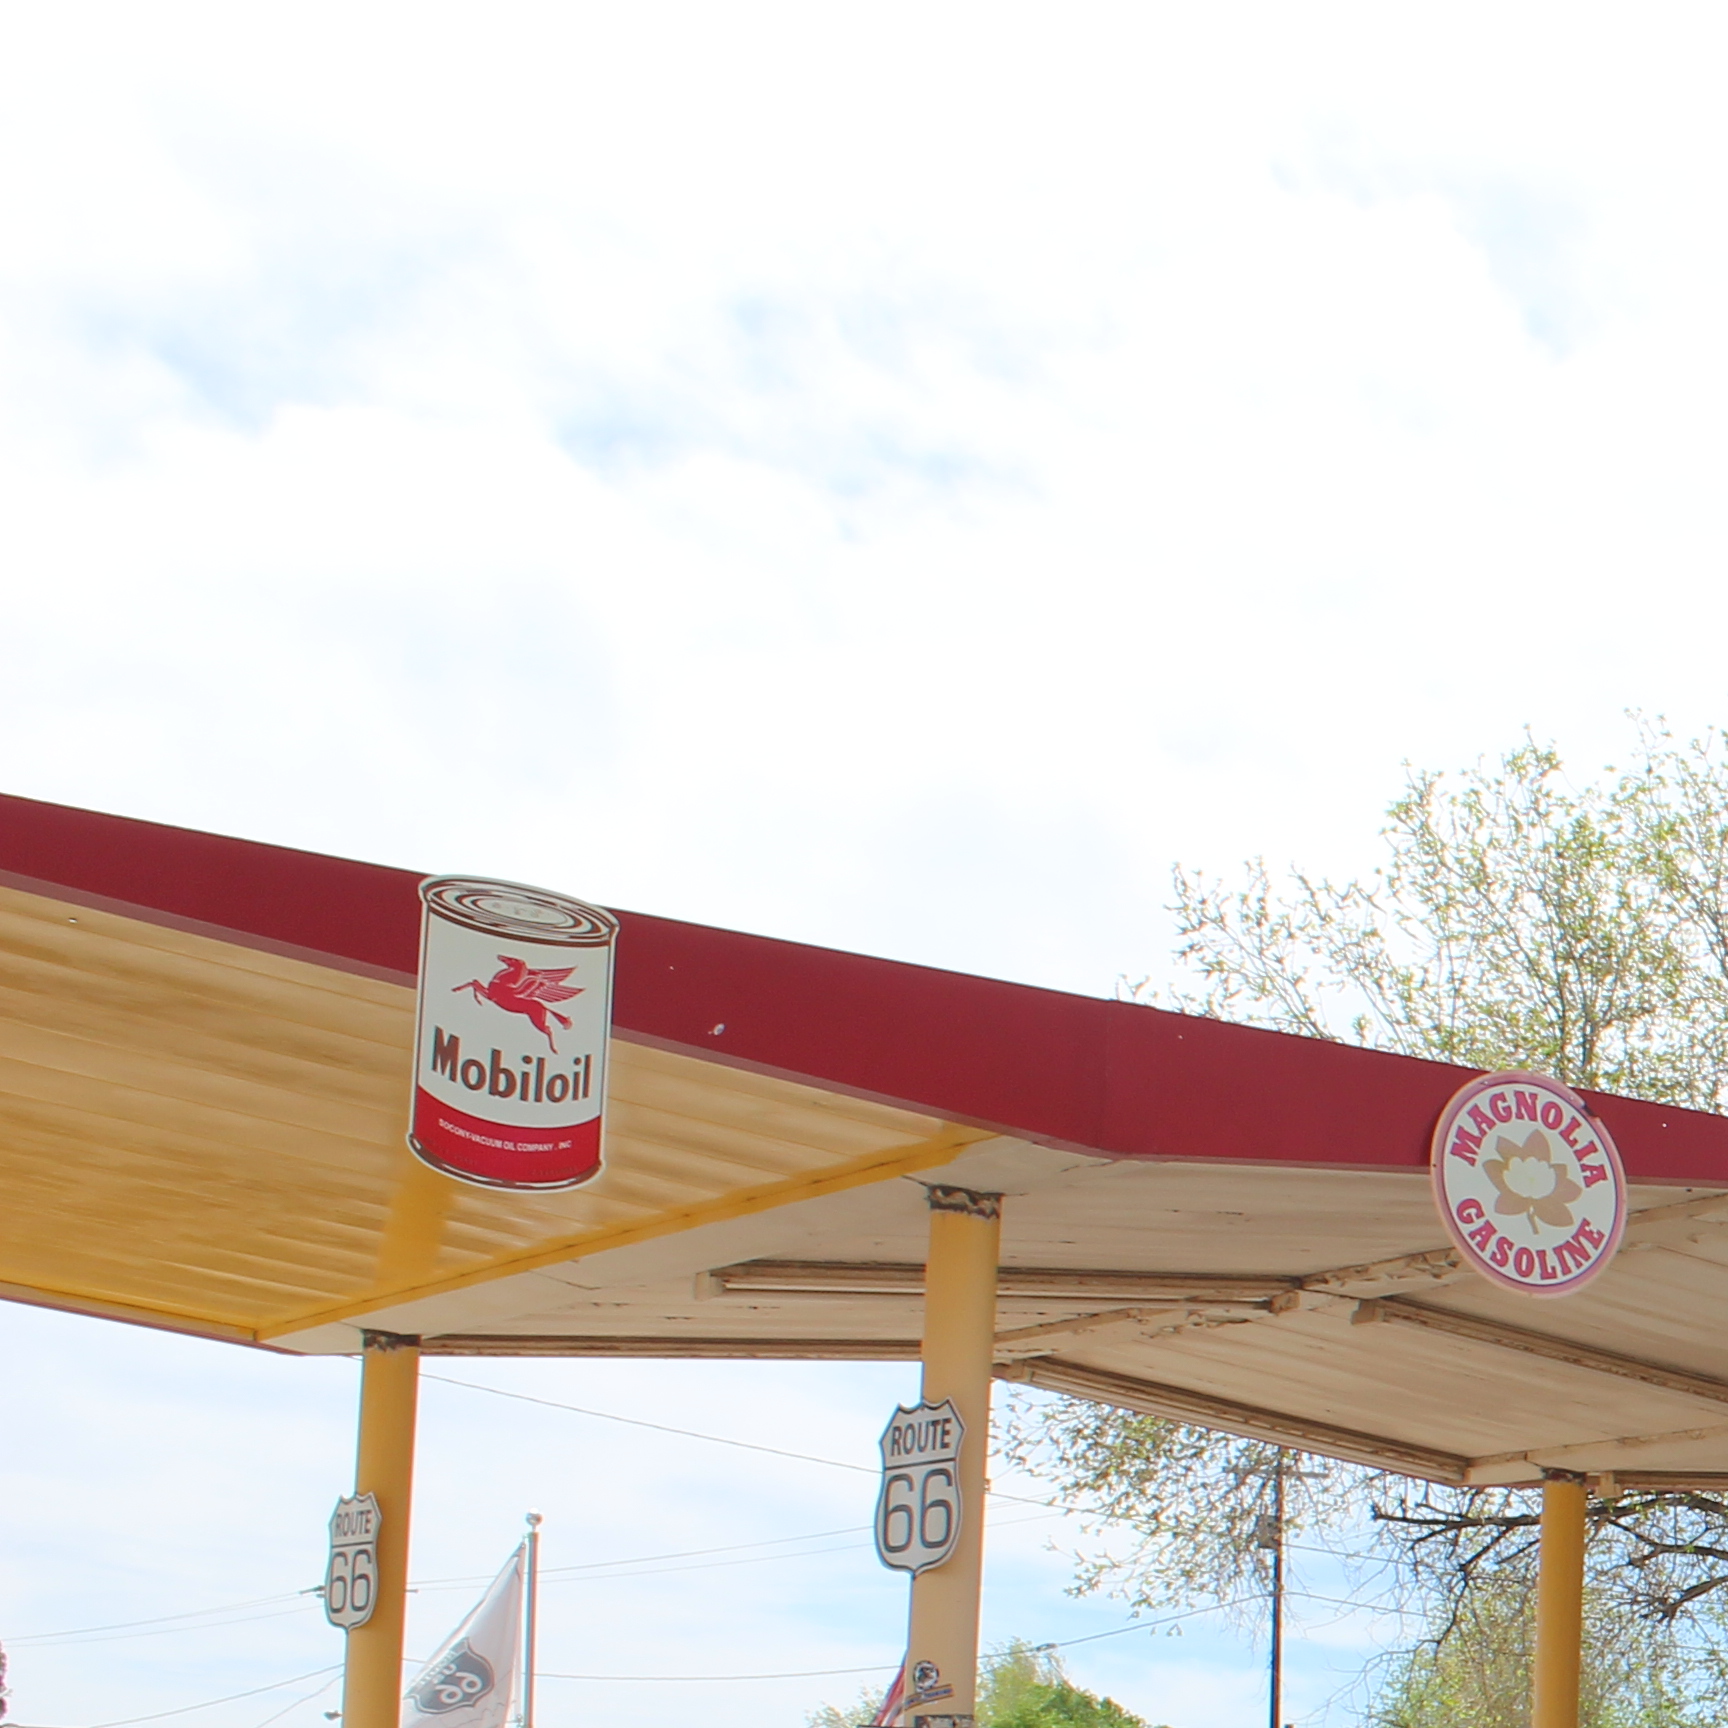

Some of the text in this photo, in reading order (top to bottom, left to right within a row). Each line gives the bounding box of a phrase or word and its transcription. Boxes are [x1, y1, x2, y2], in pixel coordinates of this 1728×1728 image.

[431, 1025, 593, 1104] Mobiloil
[1450, 1090, 1609, 1188] MAGNOLIA
[1456, 1198, 1606, 1281] GASOLINE
[890, 1416, 952, 1457] ROUTE
[334, 1509, 373, 1539] ROUTE
[883, 1468, 953, 1554] 66
[329, 1549, 373, 1614] 66
